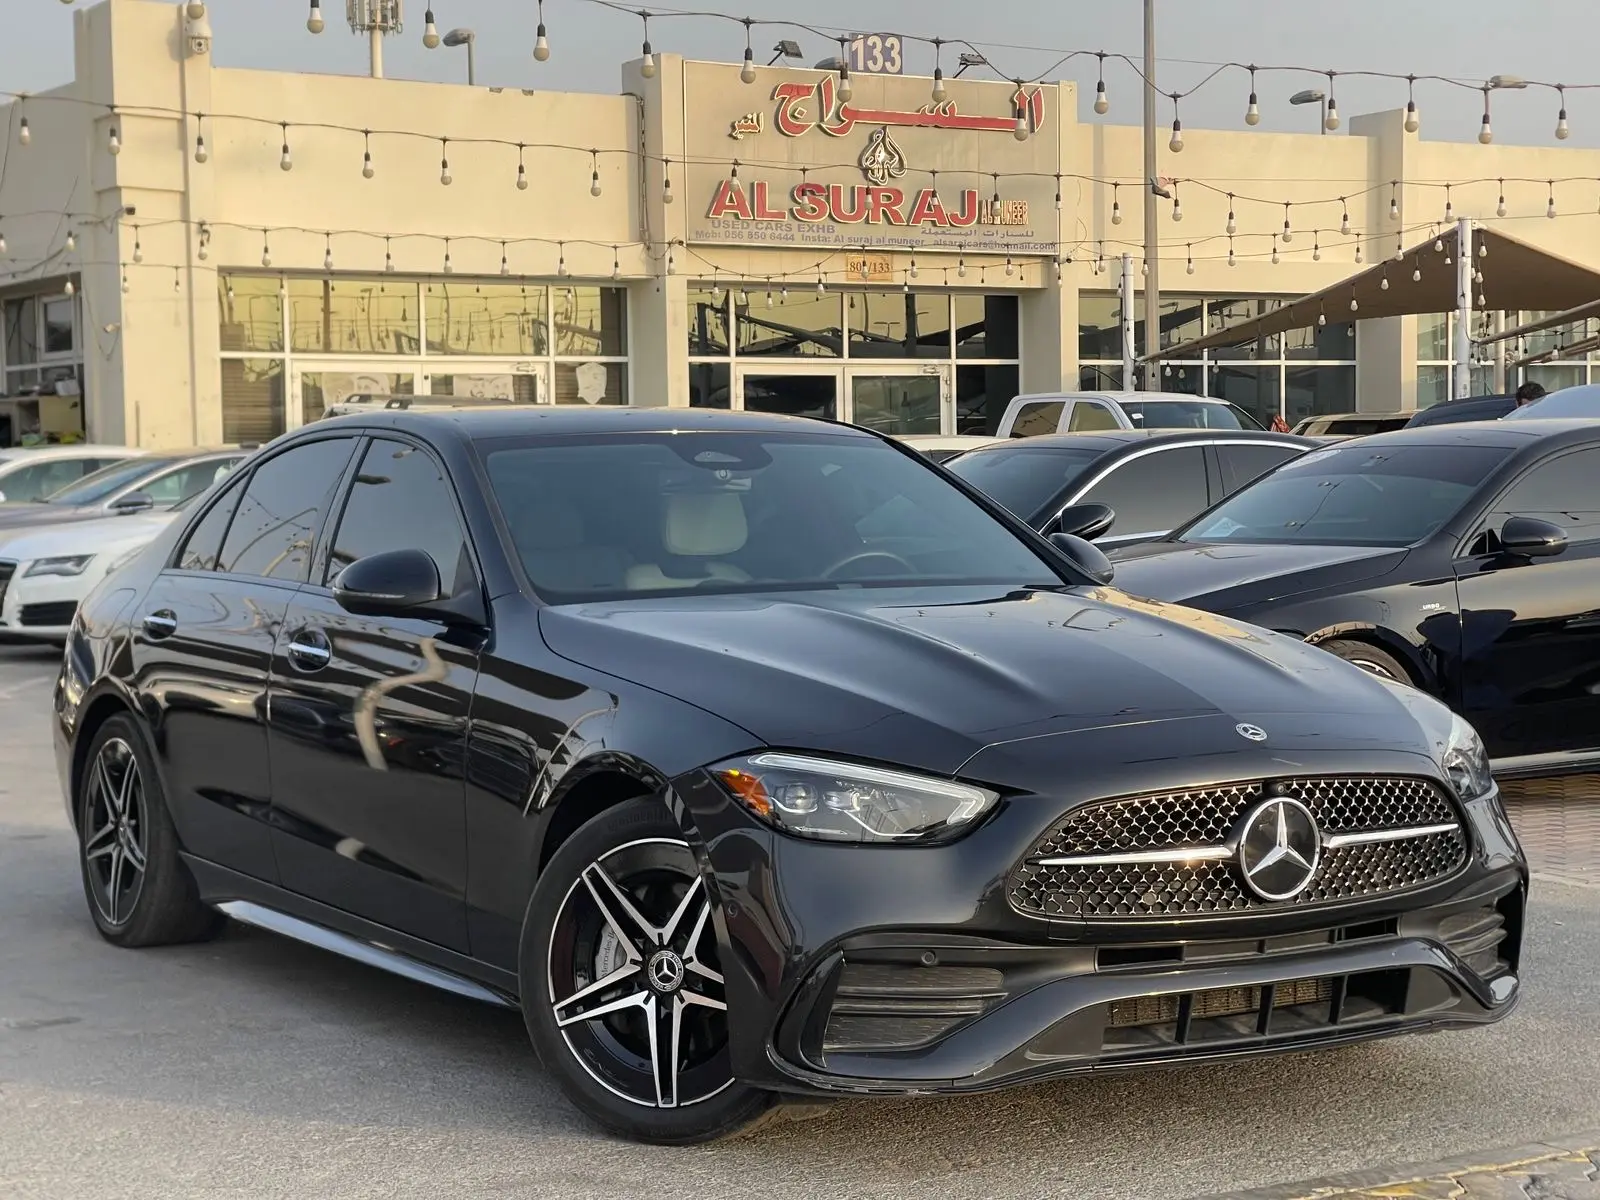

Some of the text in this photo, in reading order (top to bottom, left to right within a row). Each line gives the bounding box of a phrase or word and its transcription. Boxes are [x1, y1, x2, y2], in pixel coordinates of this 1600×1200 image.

[851, 34, 902, 74] 133
[709, 179, 788, 221] AL
[792, 182, 979, 227] SURAJ
[695, 230, 721, 239] Mob:
[801, 234, 830, 243] Insta:
[847, 235, 873, 246] suraj
[711, 219, 836, 234] USED CARS EXHB
